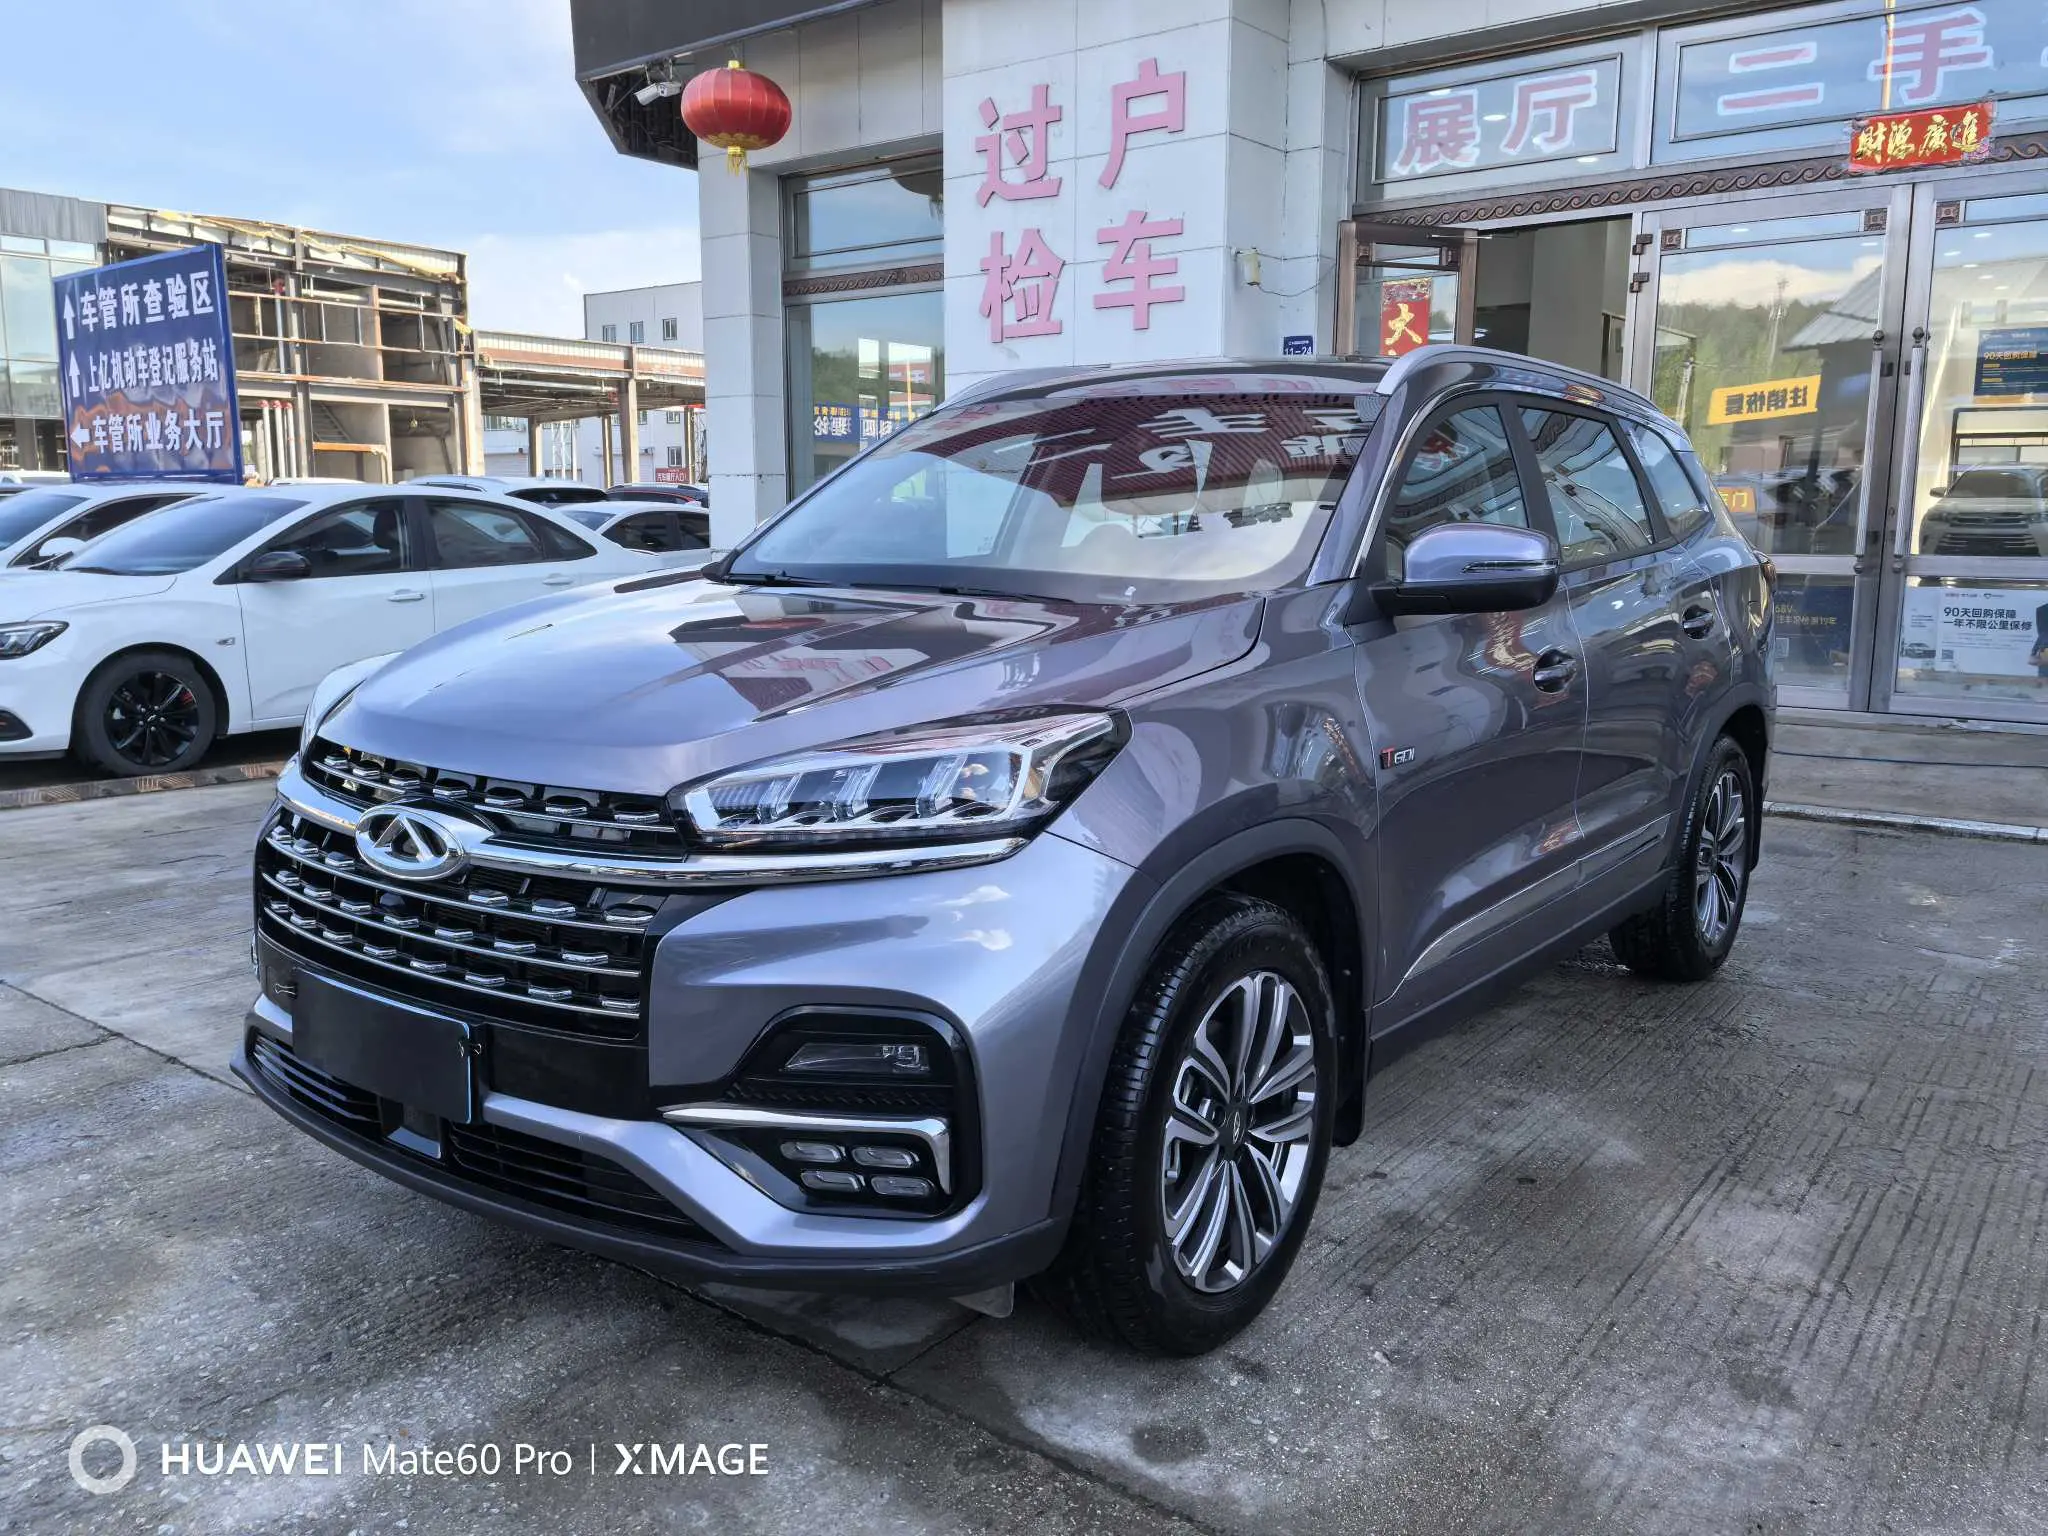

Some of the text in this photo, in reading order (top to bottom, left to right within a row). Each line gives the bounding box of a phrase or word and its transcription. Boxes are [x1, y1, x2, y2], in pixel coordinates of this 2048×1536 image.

[1716, 7, 2048, 115] 二手
[975, 57, 1187, 209] 过户
[1392, 68, 1598, 174] 展厅
[80, 271, 214, 333] 车管所查验区
[979, 210, 1186, 344] 检车
[1384, 302, 1424, 355] 大
[89, 337, 219, 393] 上亿机动车登记服务站
[92, 409, 225, 454] 车管所业务大厅
[1944, 607, 2017, 619] 90天回购保障
